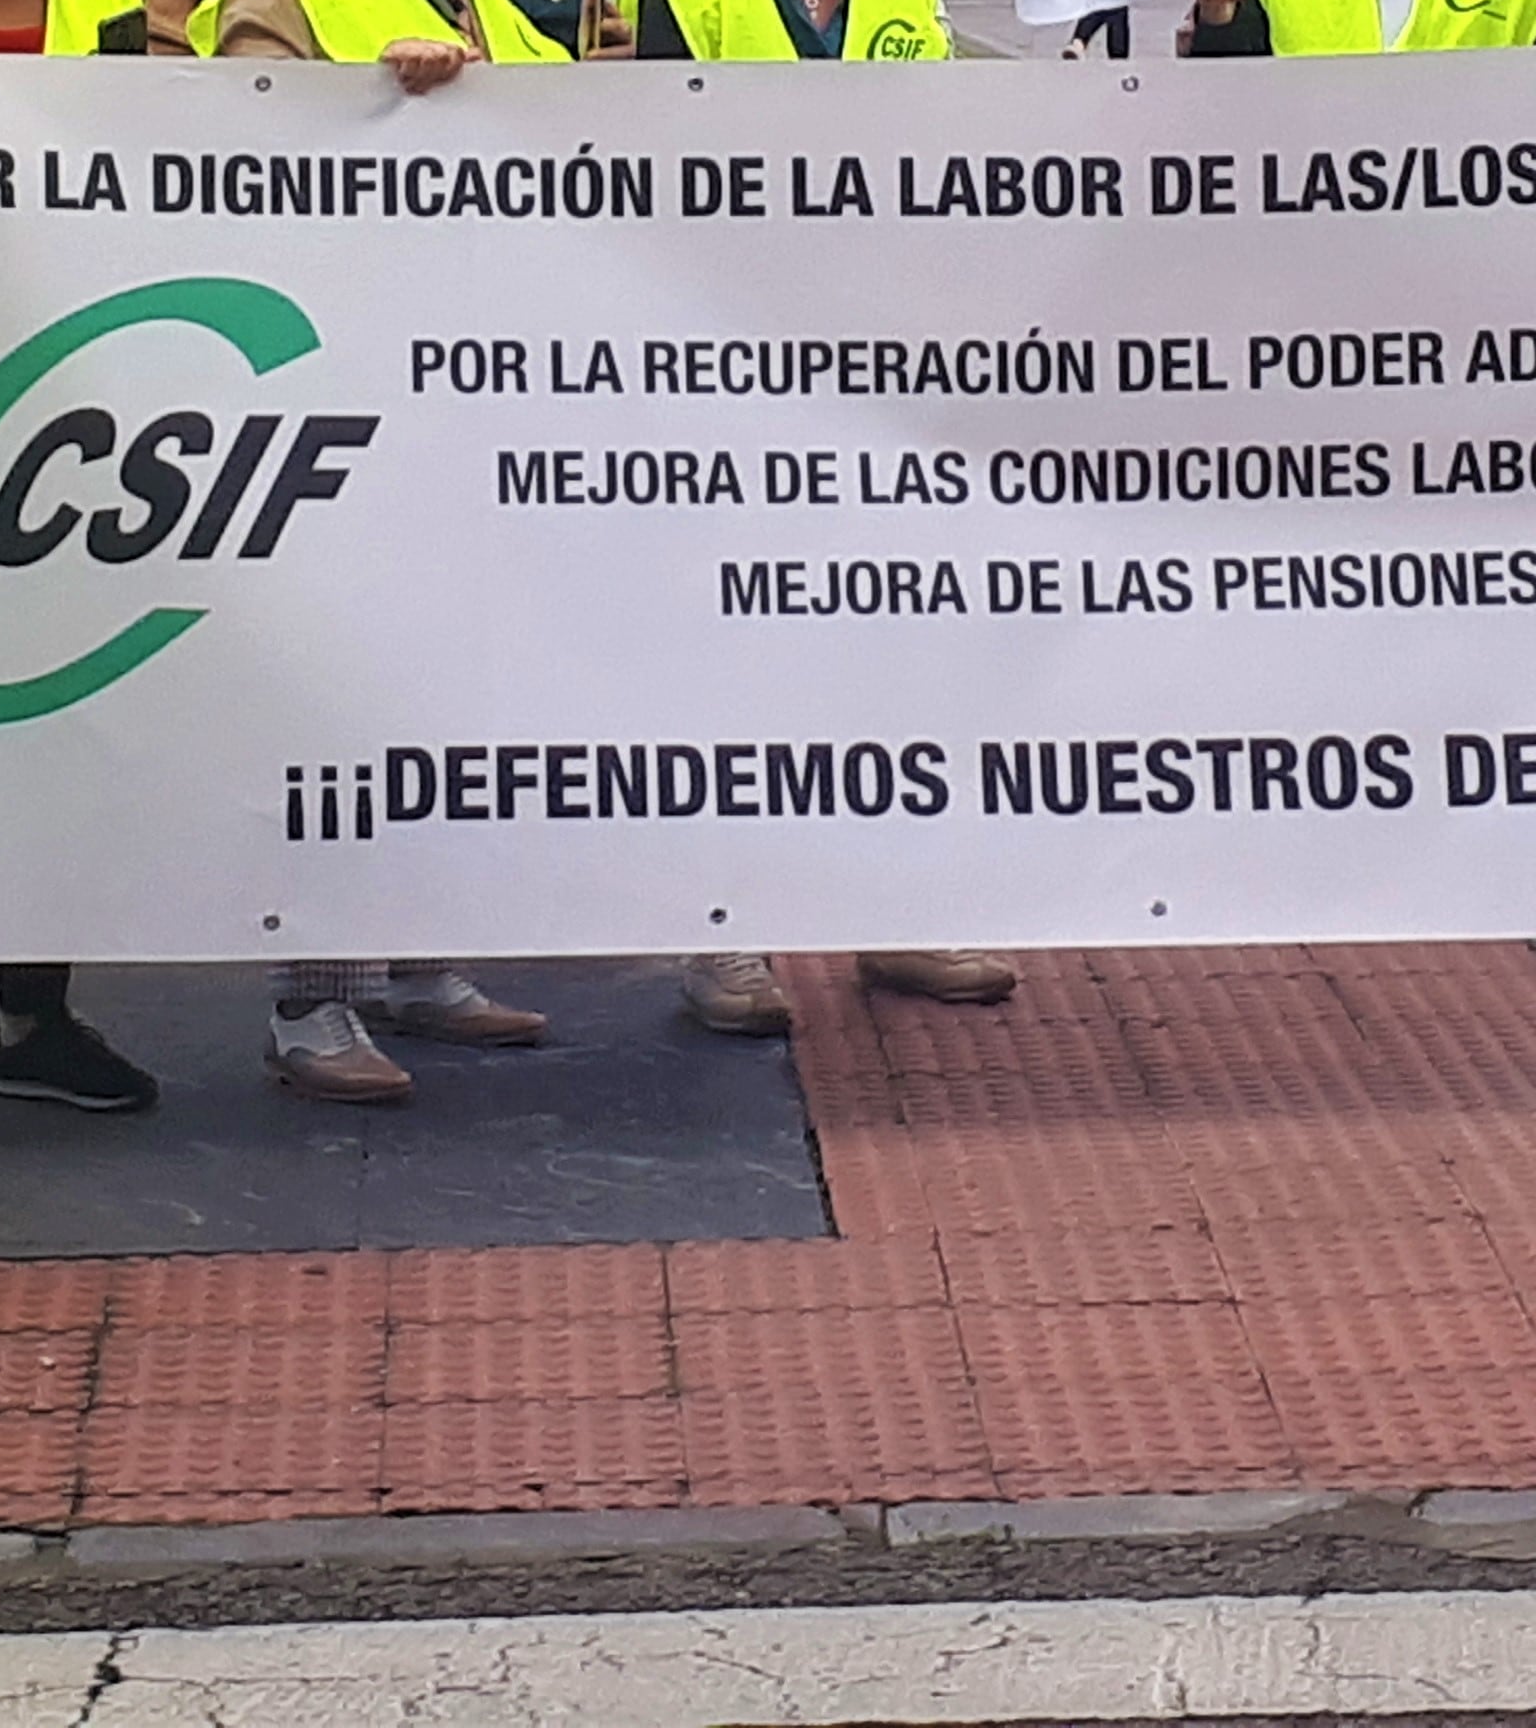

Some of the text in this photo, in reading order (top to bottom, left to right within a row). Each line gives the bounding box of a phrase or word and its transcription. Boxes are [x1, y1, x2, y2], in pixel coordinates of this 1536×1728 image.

[881, 35, 927, 60] CSIF
[45, 152, 127, 211] LA
[153, 143, 653, 219] DIGNIFICACIÓN
[681, 157, 766, 217] DE
[792, 157, 874, 217] LA
[900, 156, 1123, 218] LABOR
[1151, 155, 1236, 216] DE
[412, 340, 527, 394] POR
[551, 340, 624, 393] LA
[644, 328, 1095, 395] RECUPERACIÓN
[1118, 337, 1228, 392] DEL
[1249, 331, 1445, 390] PODER
[498, 451, 744, 505] MEJORA
[765, 452, 839, 504] DE
[859, 451, 969, 505] LAS
[989, 443, 1391, 504] CONDICIONES
[721, 561, 967, 615] MEJORA
[987, 561, 1062, 614] DE
[1082, 559, 1193, 613] LAS
[286, 742, 949, 841] ¡¡¡DEFENDEMOS
[981, 734, 1413, 815] NUESTROS
